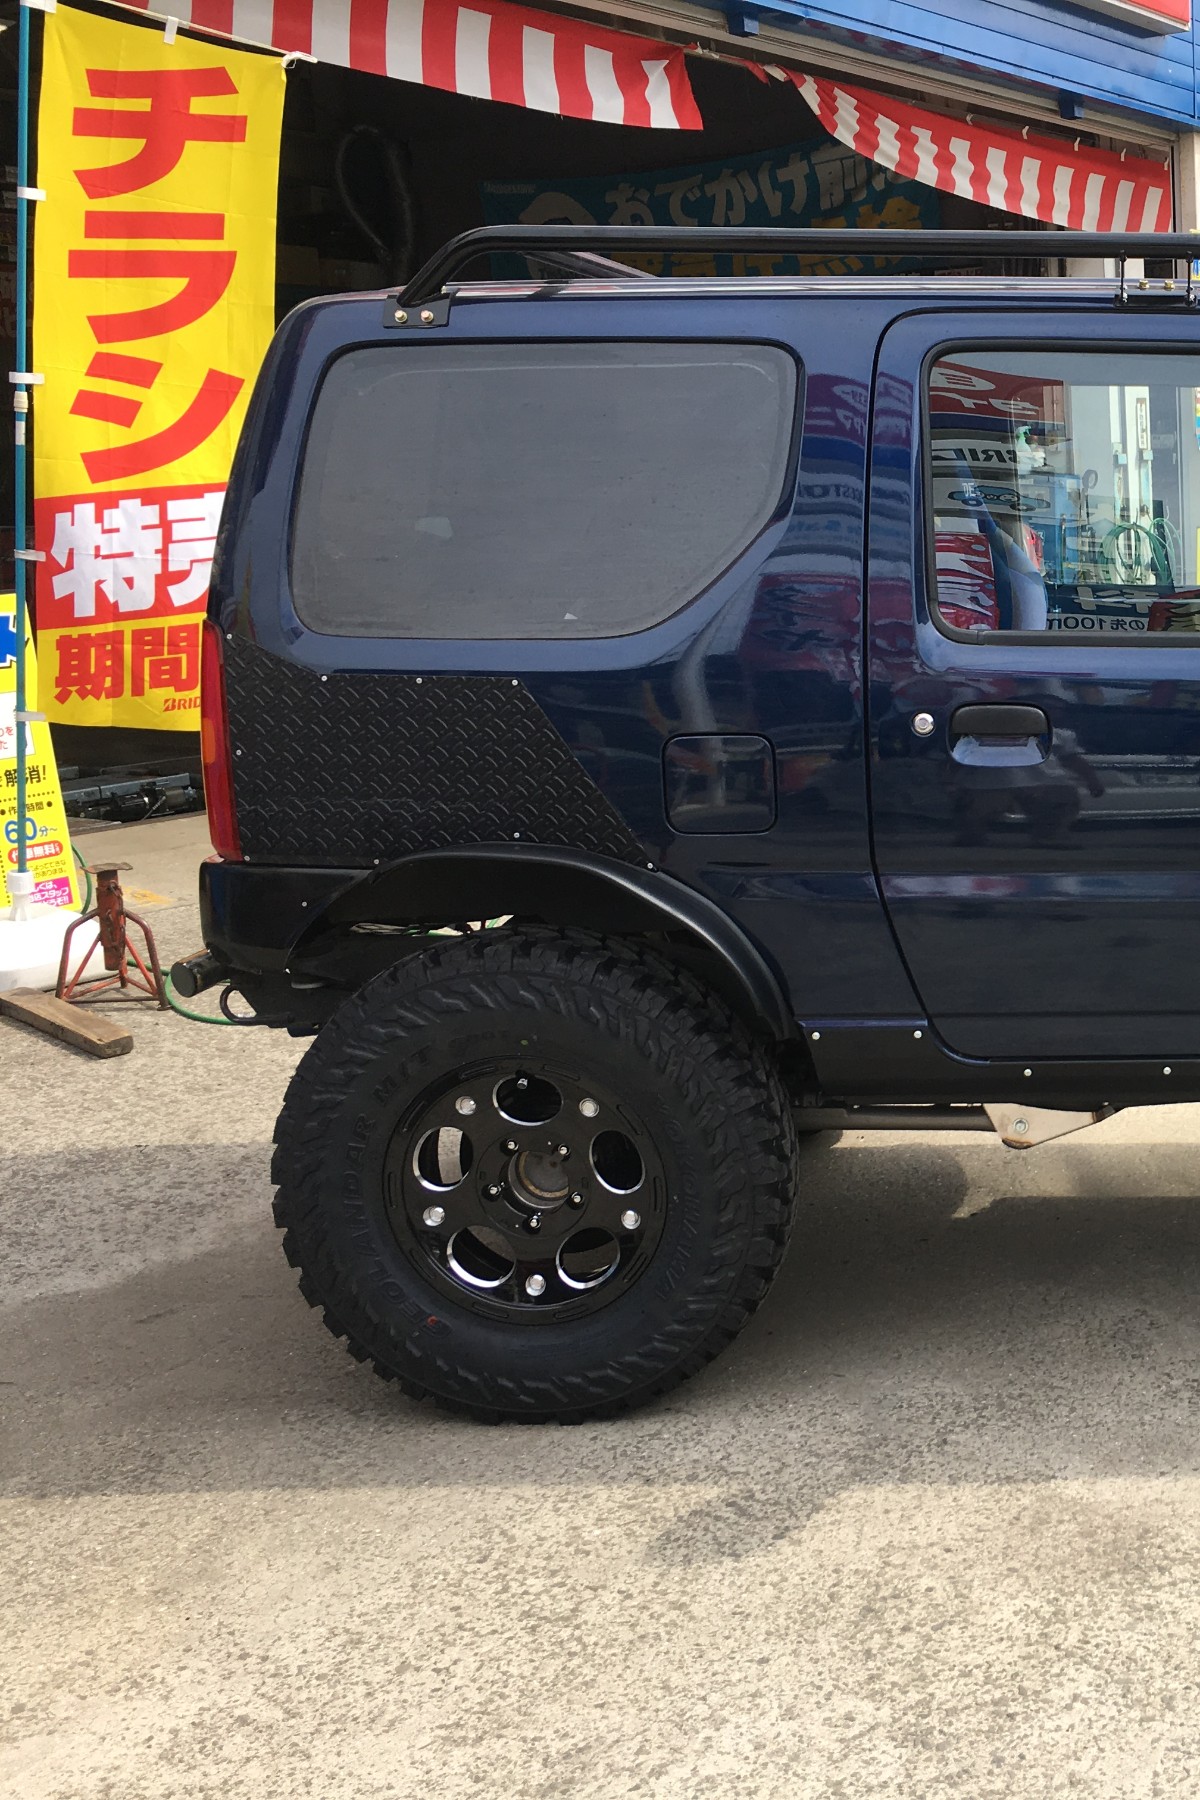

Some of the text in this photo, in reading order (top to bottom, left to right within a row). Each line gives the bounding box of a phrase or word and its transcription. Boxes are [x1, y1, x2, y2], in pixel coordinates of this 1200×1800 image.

[68, 67, 248, 484] チラシ
[54, 623, 200, 705] 期間
[0, 764, 46, 788] 解消!
[8, 801, 45, 816] 作時間
